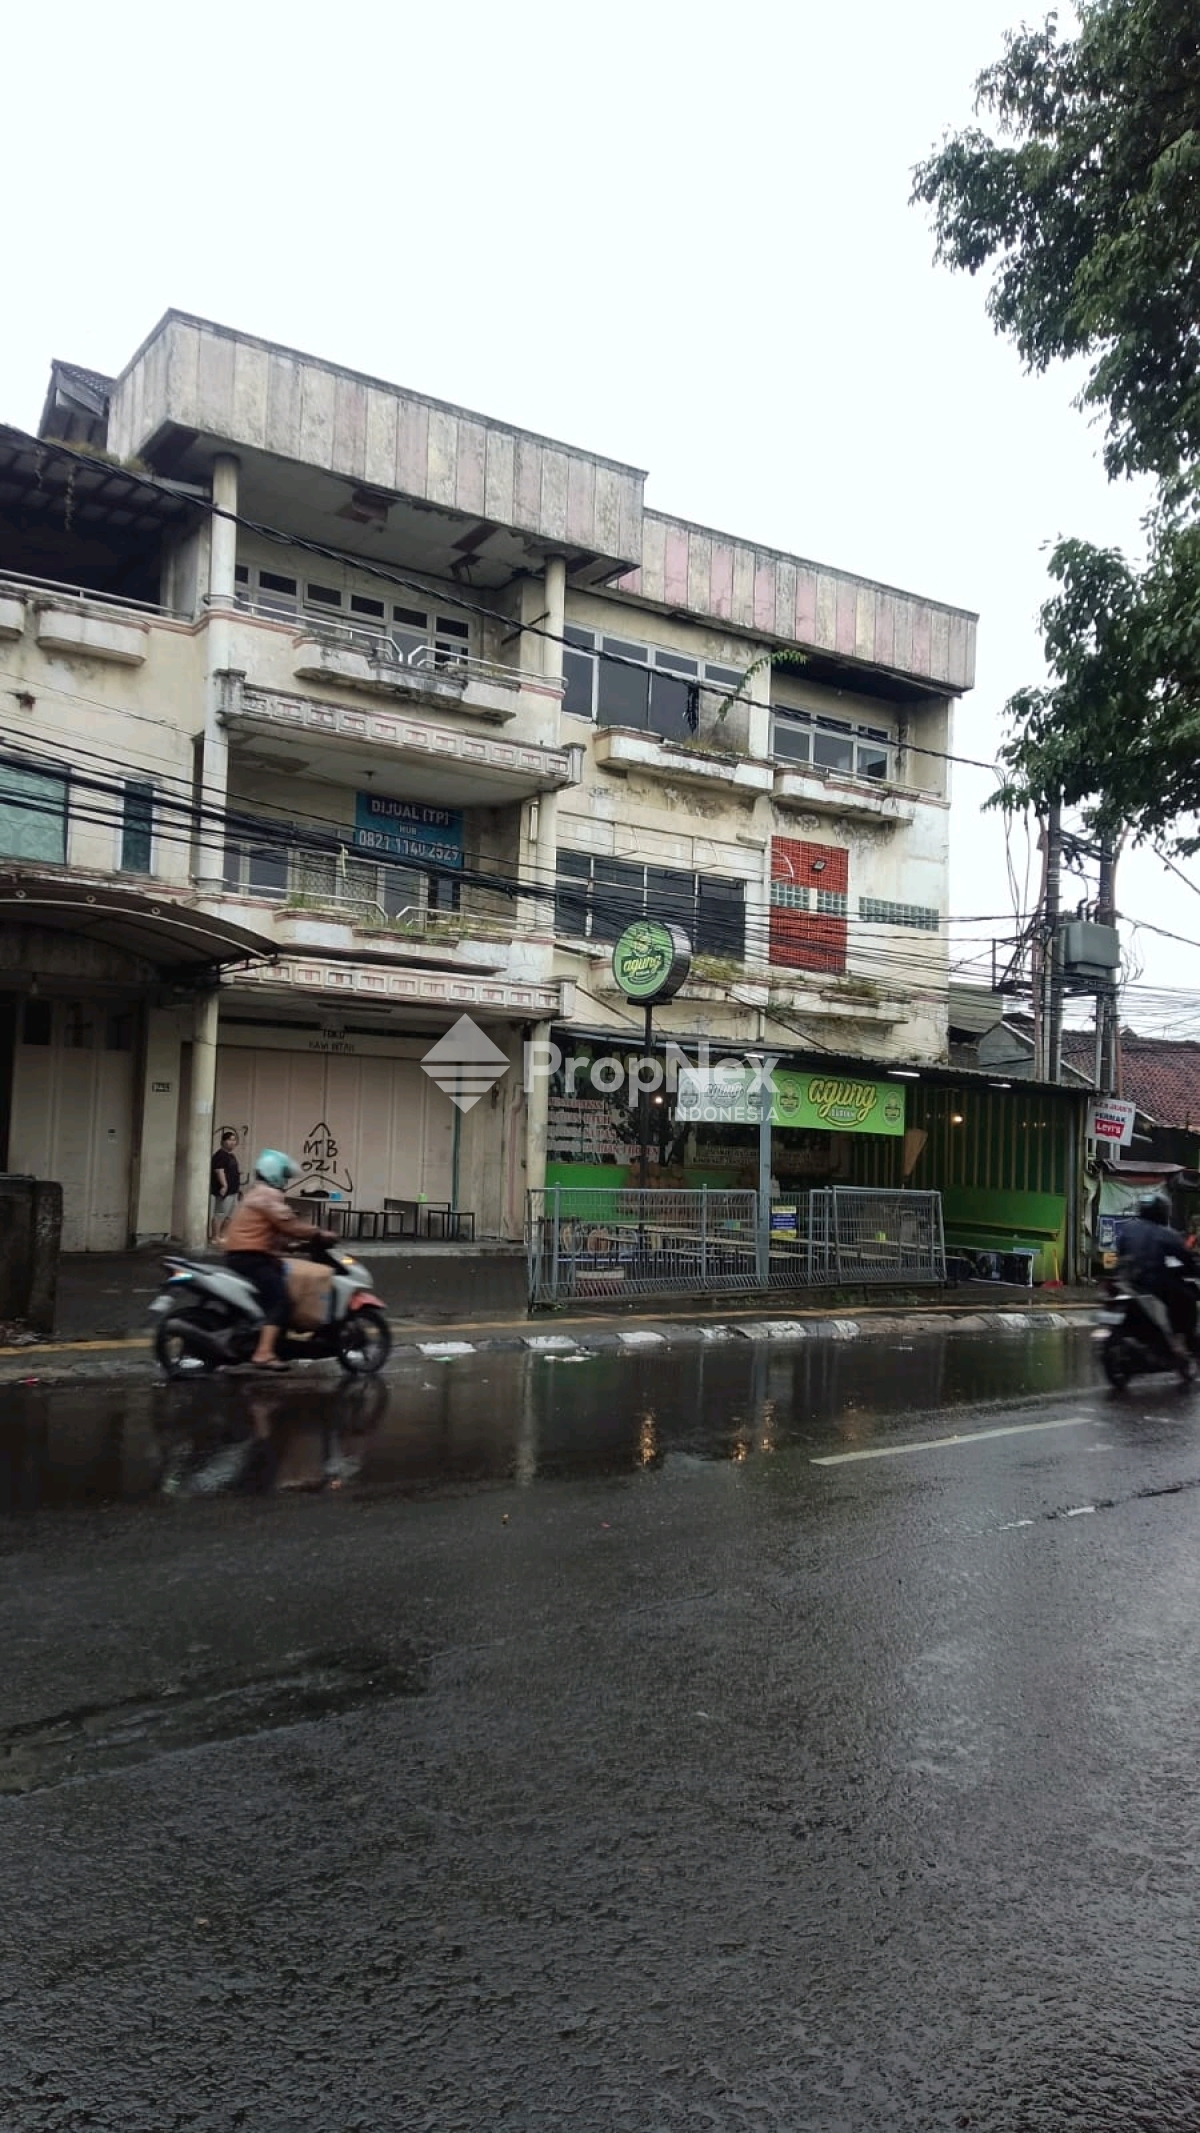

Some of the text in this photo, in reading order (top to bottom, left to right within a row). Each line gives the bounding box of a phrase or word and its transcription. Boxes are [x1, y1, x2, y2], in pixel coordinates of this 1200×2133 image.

[371, 799, 419, 820] DIJUAL
[359, 829, 390, 851] 0821
[808, 1079, 876, 1119] agung
